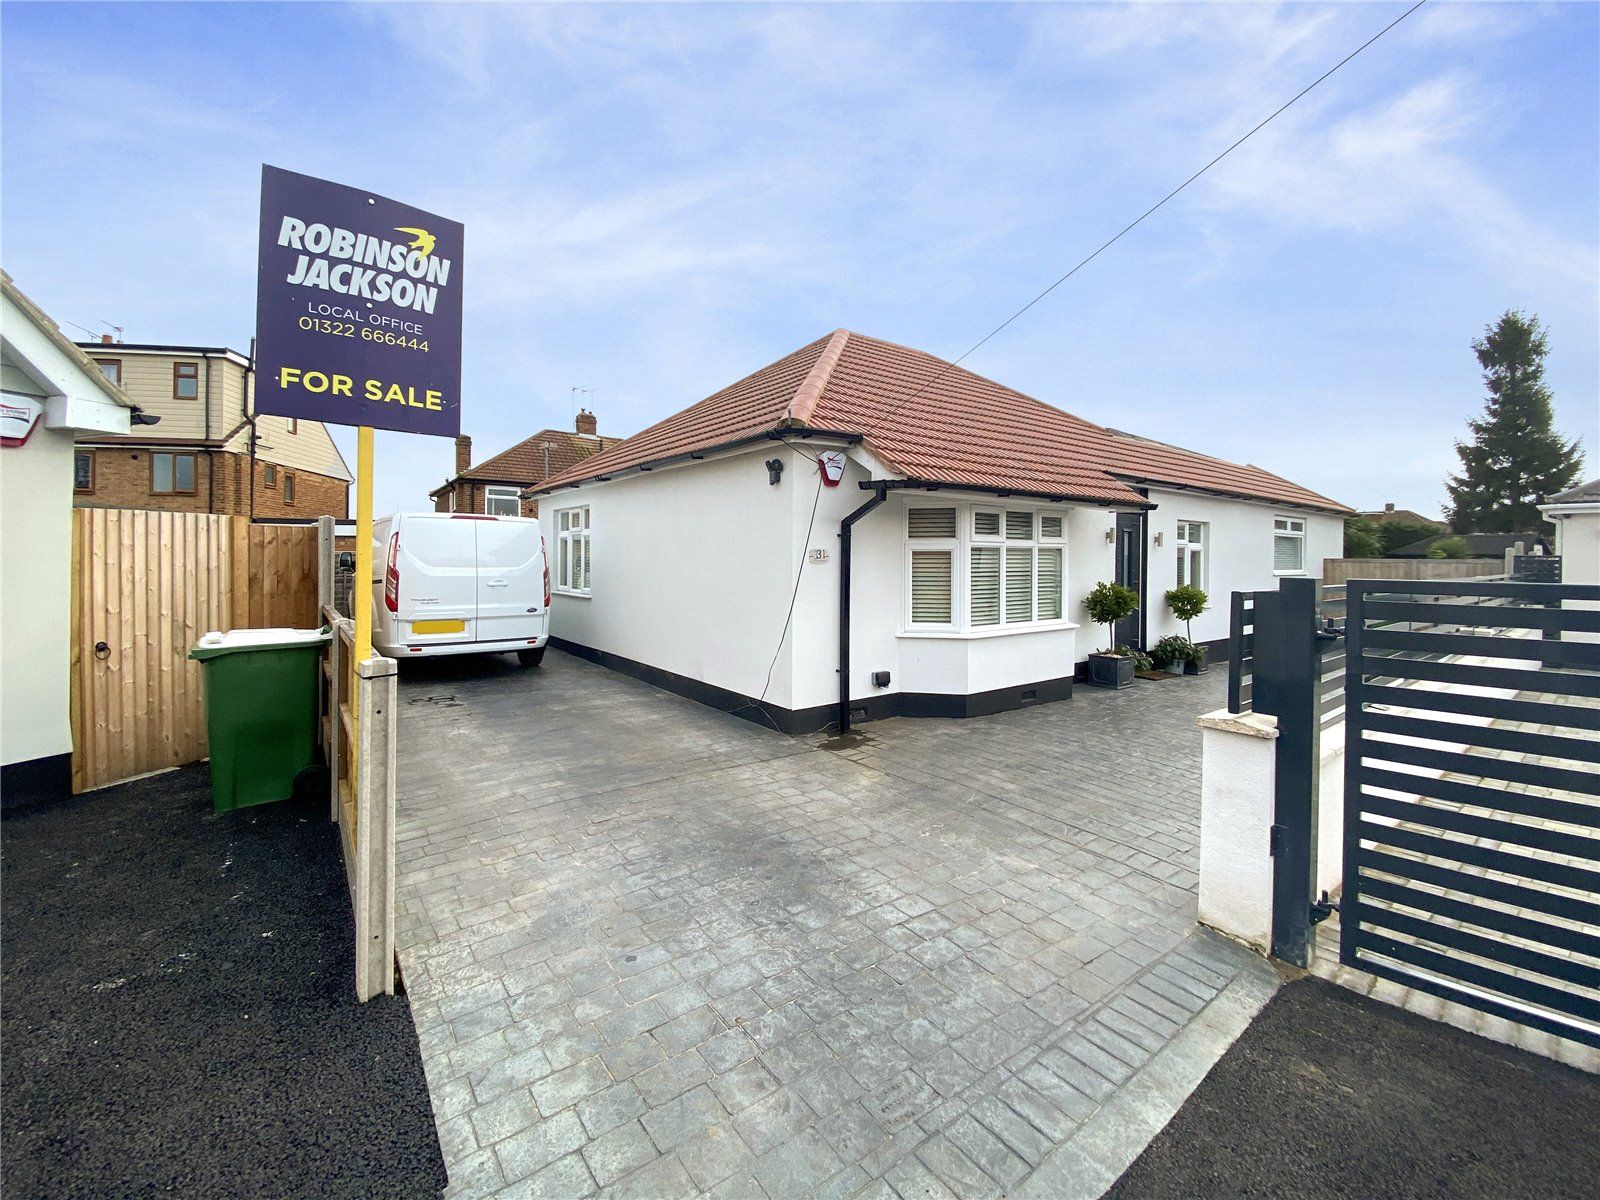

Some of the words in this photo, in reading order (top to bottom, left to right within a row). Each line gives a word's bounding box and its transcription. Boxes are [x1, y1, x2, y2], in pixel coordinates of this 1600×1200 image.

[277, 216, 451, 286] ROBINSON
[286, 255, 438, 315] JACKSON
[299, 317, 355, 338] 01322
[361, 328, 430, 353] 666444
[308, 302, 364, 323] LOCAL
[369, 314, 423, 336] OFFICE
[280, 367, 354, 397] FOR
[364, 380, 442, 411] SALE
